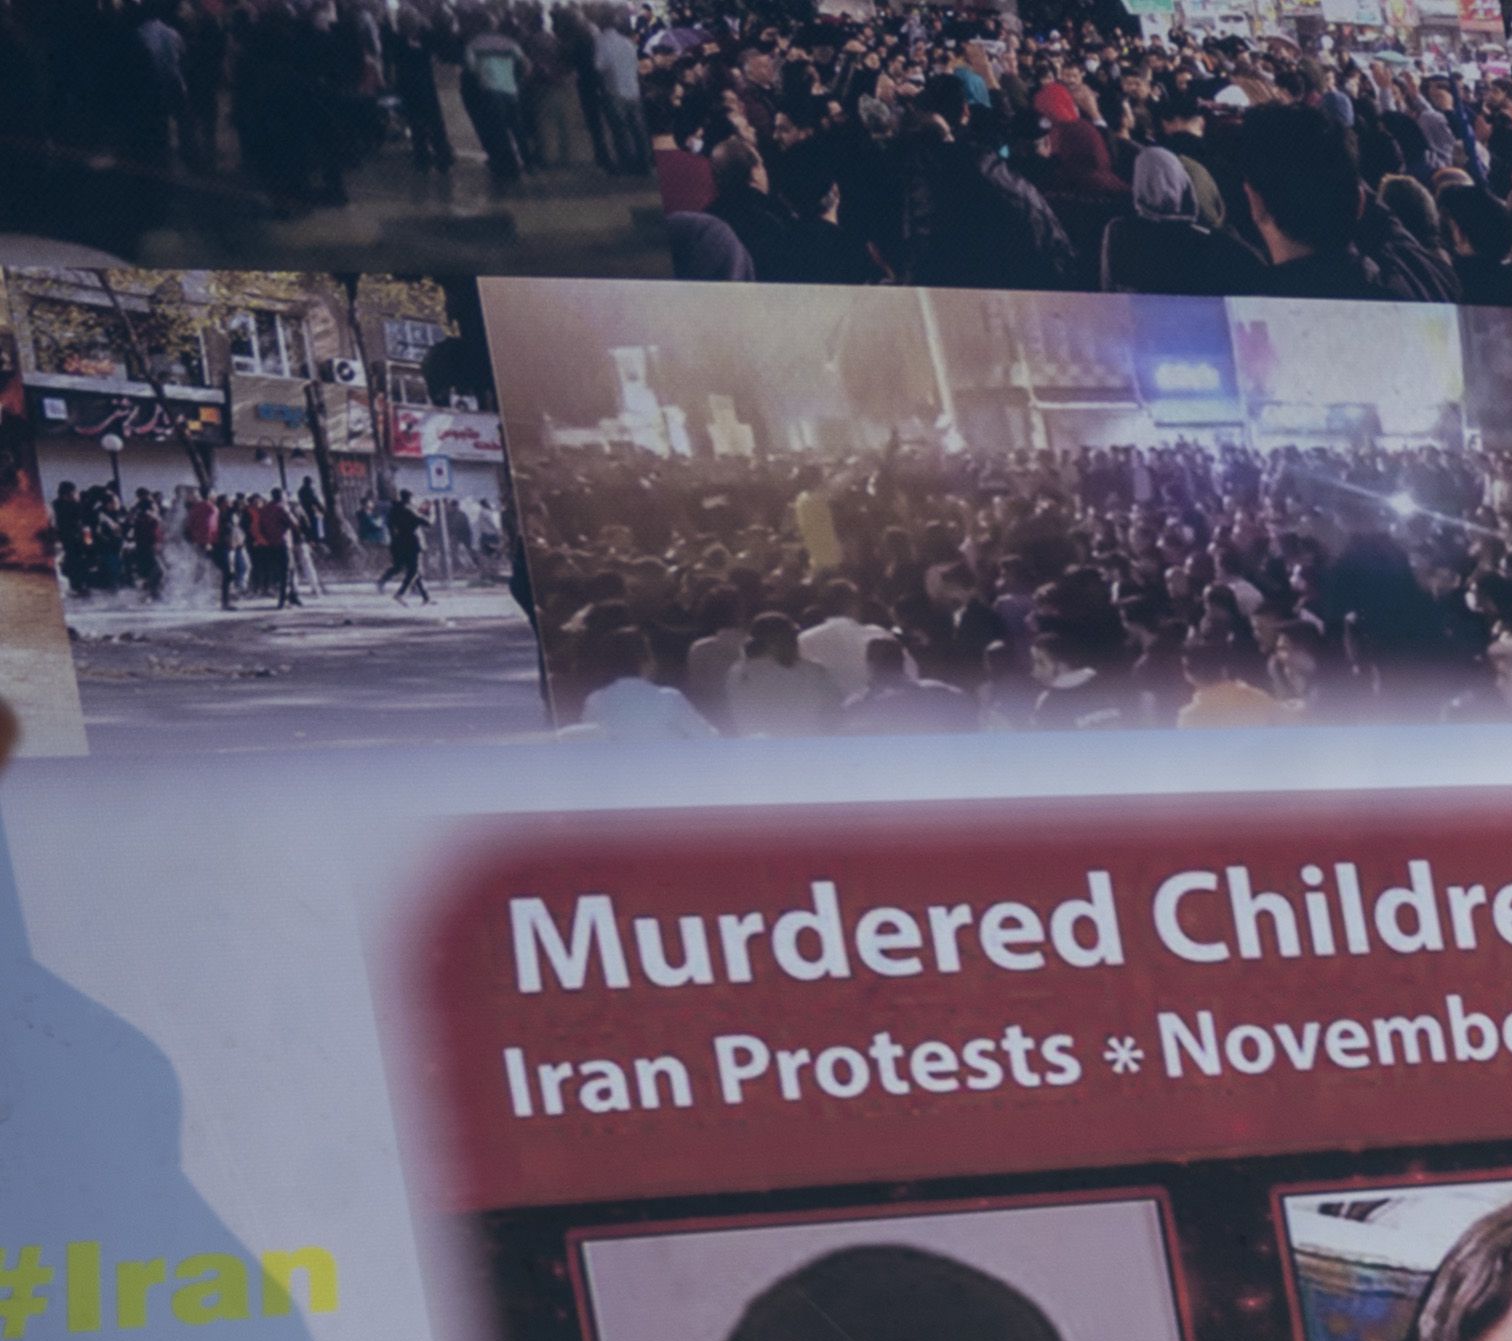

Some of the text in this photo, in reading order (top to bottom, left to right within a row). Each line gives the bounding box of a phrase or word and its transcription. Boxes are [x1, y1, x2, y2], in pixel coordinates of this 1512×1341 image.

[510, 869, 1123, 994] Murdered
[503, 1043, 691, 1119] Iran
[715, 1021, 1084, 1106] Protests
[0, 1240, 340, 1341] #Iran
